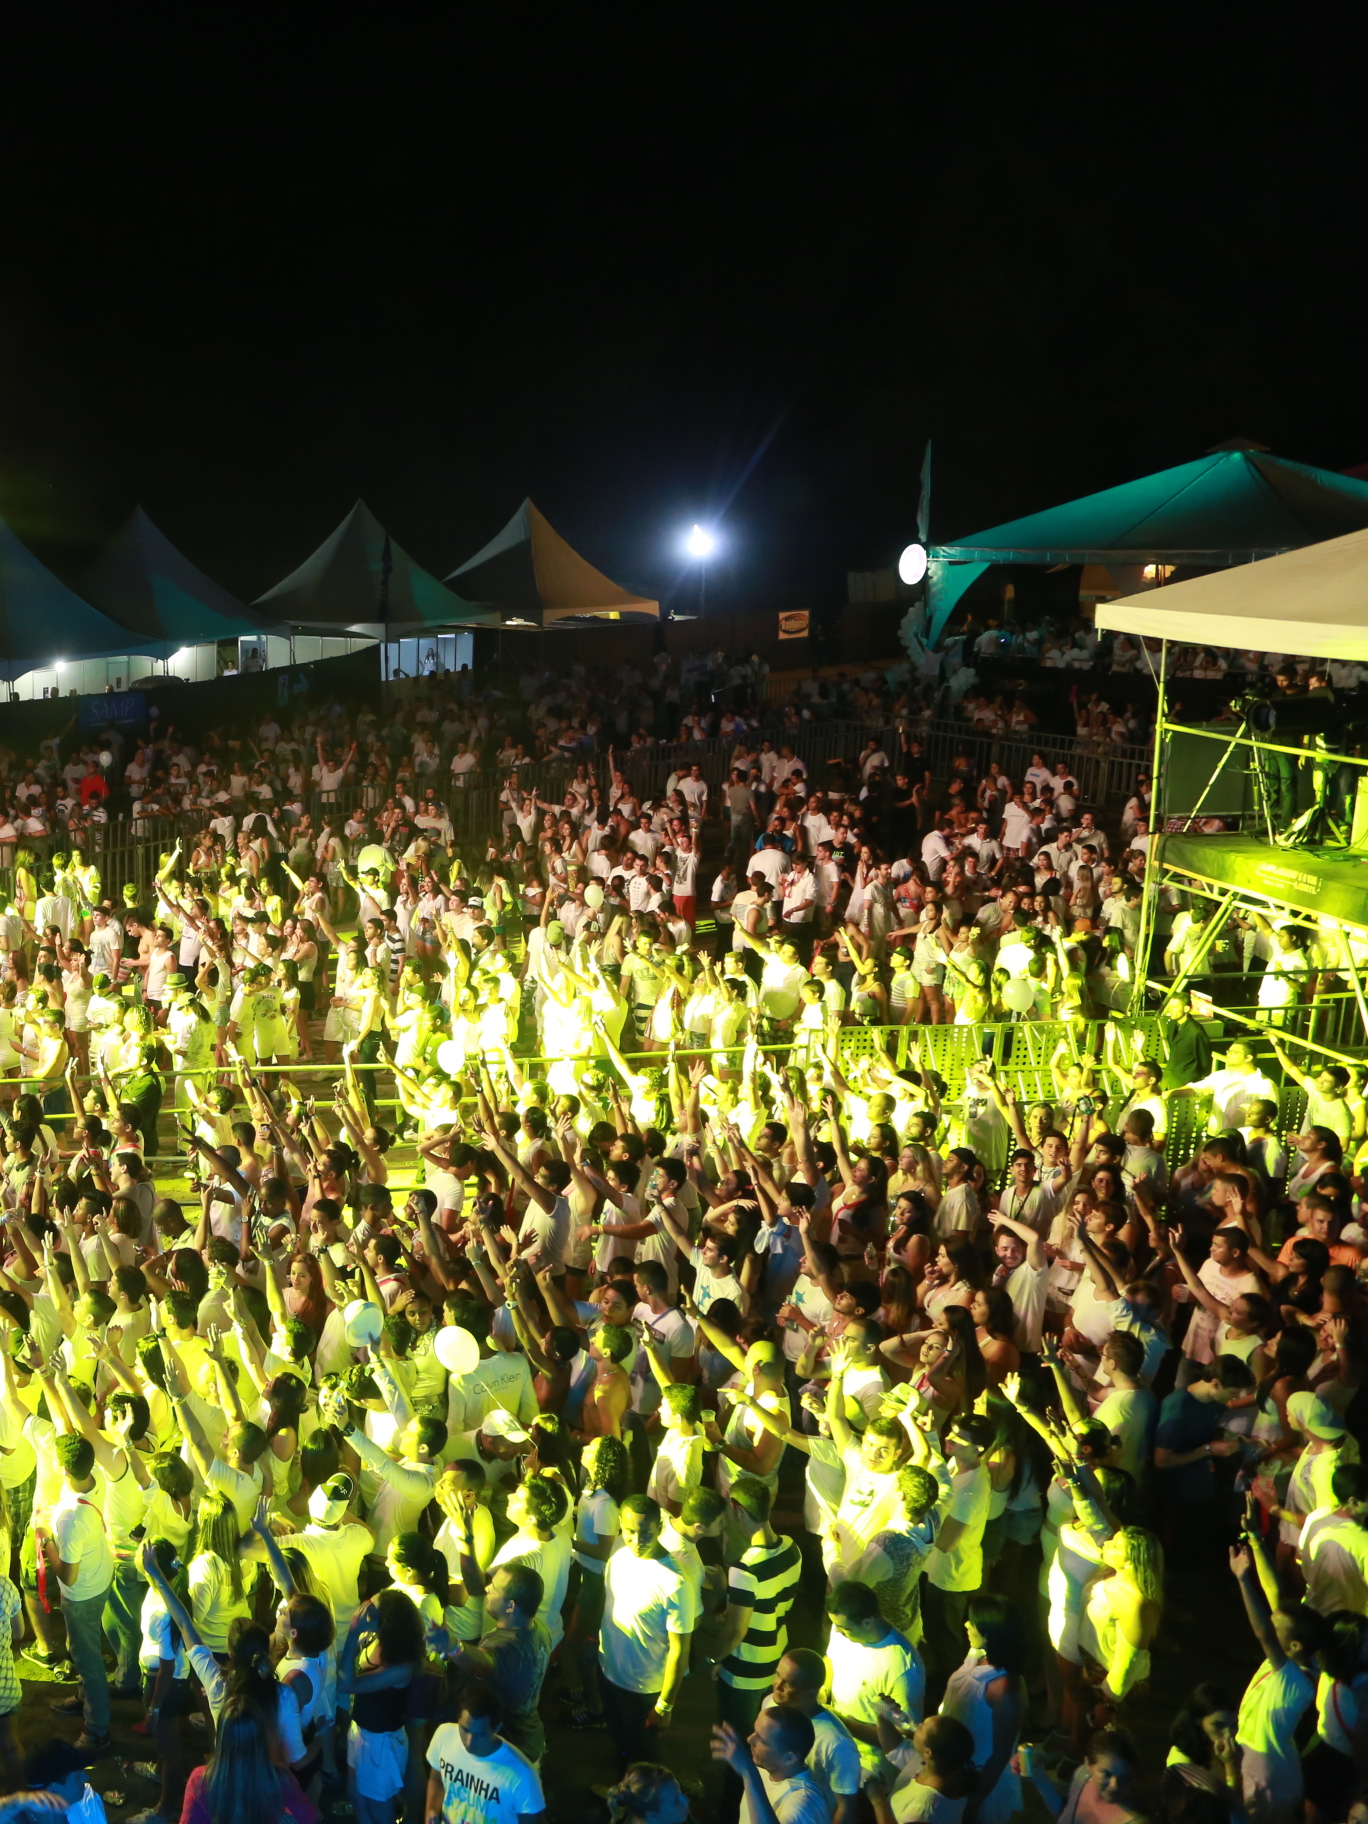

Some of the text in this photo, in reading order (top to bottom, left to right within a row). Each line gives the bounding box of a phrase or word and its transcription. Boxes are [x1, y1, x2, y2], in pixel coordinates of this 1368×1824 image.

[90, 697, 135, 722] SAMP
[473, 1379, 500, 1395] Calvin
[499, 1371, 521, 1384] Klein
[440, 1757, 501, 1804] PRAINHA
